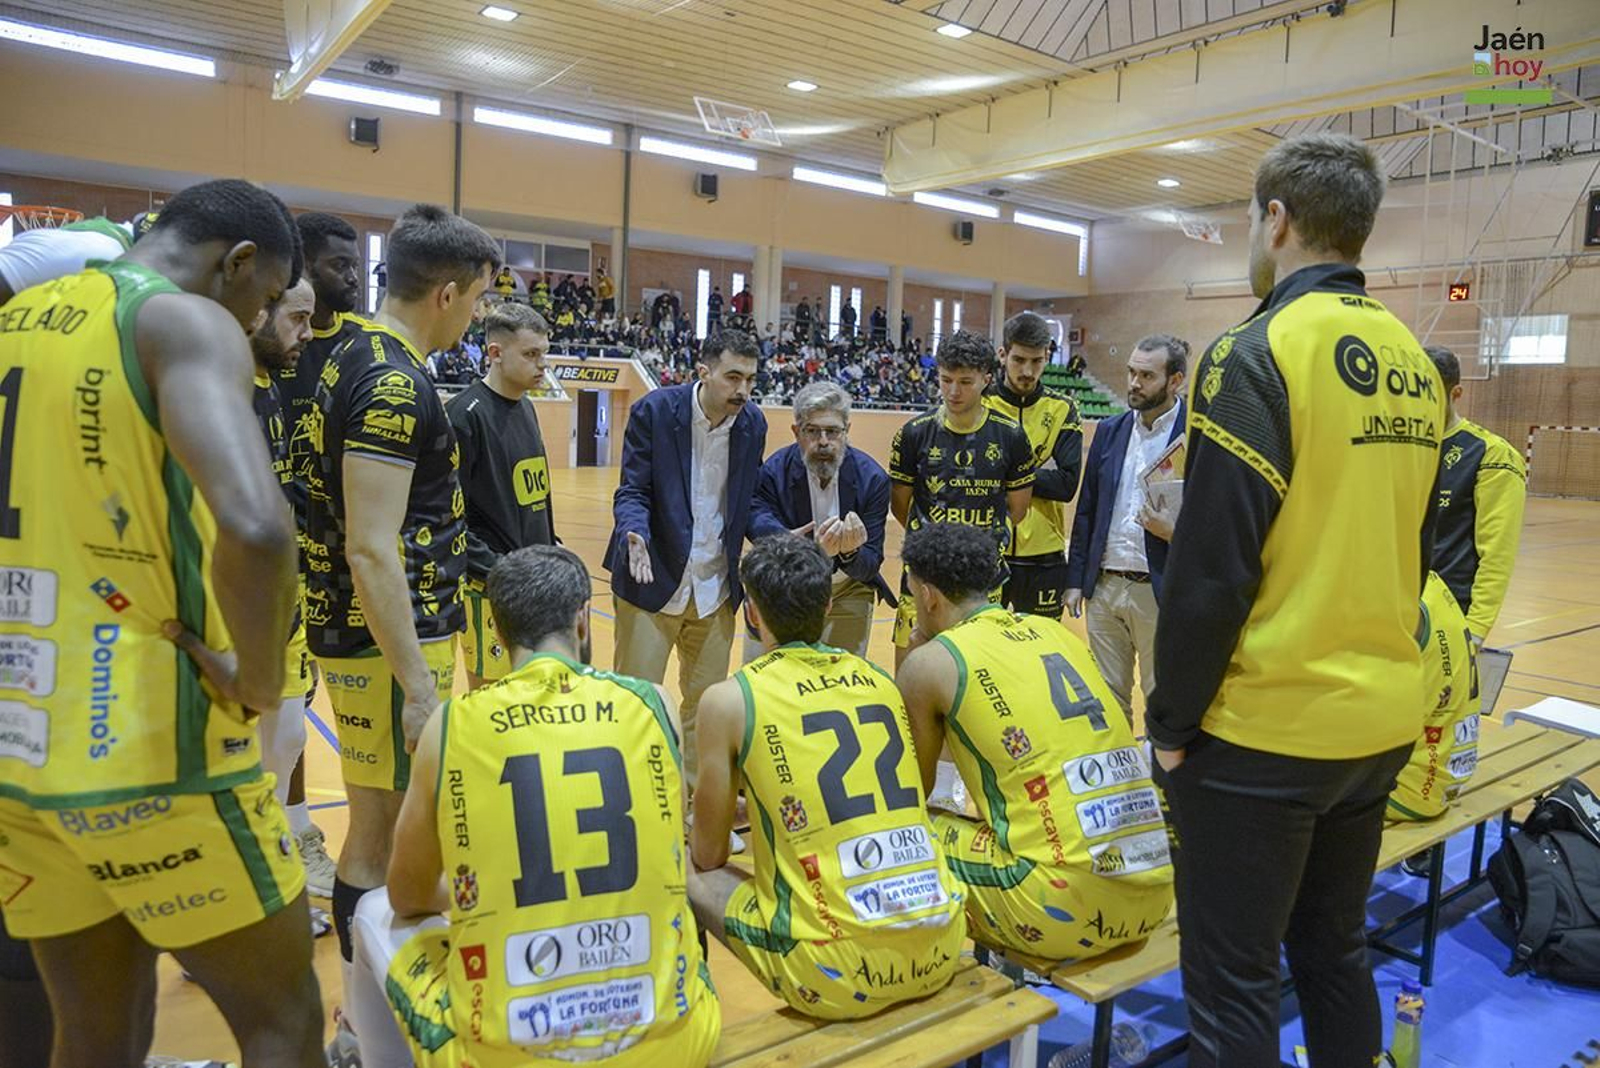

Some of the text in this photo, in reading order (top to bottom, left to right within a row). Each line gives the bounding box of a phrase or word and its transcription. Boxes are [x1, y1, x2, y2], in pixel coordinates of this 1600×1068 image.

[1450, 288, 1467, 300] 24
[554, 367, 617, 381] #BEACTIVE
[89, 624, 121, 760] Domino's
[796, 670, 877, 697] ALEMÁN
[974, 668, 1014, 719] RUSTER
[1039, 652, 1110, 731] 4
[490, 701, 619, 734] SERGIO M.
[763, 725, 791, 785] RUSTER
[802, 704, 919, 825] 22
[1107, 748, 1138, 769] ORO
[447, 769, 470, 851] RUSTER
[499, 746, 639, 908] 13
[889, 827, 926, 849] ORO
[87, 846, 203, 881] Blanca
[886, 890, 900, 901] LA
[577, 919, 631, 949] ORO
[560, 993, 640, 1021] LA FORTUNA
